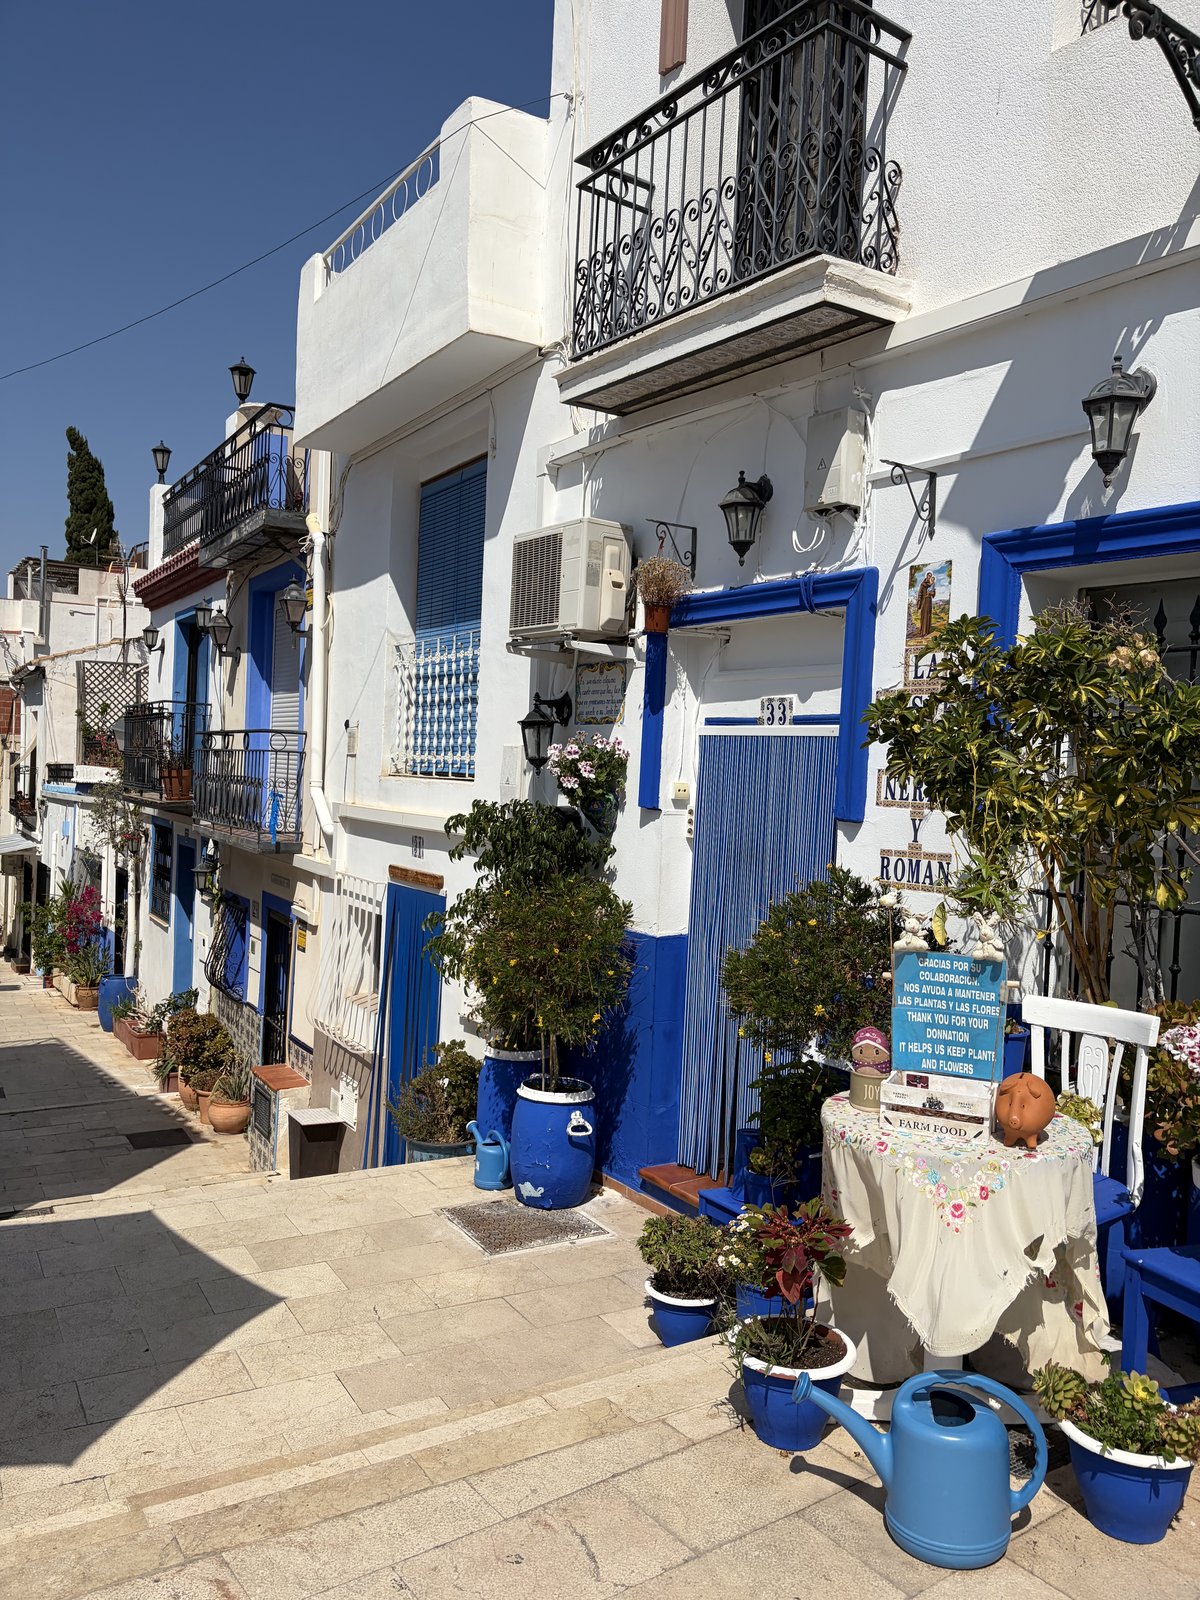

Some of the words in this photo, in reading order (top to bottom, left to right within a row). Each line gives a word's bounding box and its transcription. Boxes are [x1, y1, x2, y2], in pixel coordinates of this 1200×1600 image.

[912, 653, 938, 680] LA
[766, 702, 787, 726] 33
[884, 775, 932, 803] NER
[910, 817, 924, 843] Y
[879, 855, 952, 887] ROMAN
[918, 957, 951, 970] GRACIAS
[953, 960, 969, 971] POR
[970, 962, 981, 973] SU
[903, 982, 920, 993] NOS
[921, 984, 946, 996] AYUDA
[948, 988, 953, 997] A
[954, 988, 996, 1002] MANTENER
[897, 995, 912, 1006] LAS
[914, 997, 947, 1010] PLANTAS
[948, 1001, 954, 1010] Y
[955, 1002, 970, 1013] LAS
[972, 1004, 1000, 1017] FLORES
[907, 1011, 932, 1023] THANK
[934, 1014, 949, 1025] YOU
[951, 1015, 967, 1027] FOR
[967, 1017, 989, 1030] YOUR
[926, 1027, 970, 1043] DONNATION
[899, 1041, 906, 1052] IT
[908, 1042, 933, 1054] HELPS
[934, 1044, 945, 1055] US
[946, 1046, 966, 1058] KEEP
[921, 1058, 937, 1070] AND
[939, 1060, 974, 1075] FLOWERS
[863, 1084, 881, 1100] JOY
[899, 1118, 930, 1132] FARM
[933, 1124, 967, 1137] FOOD
